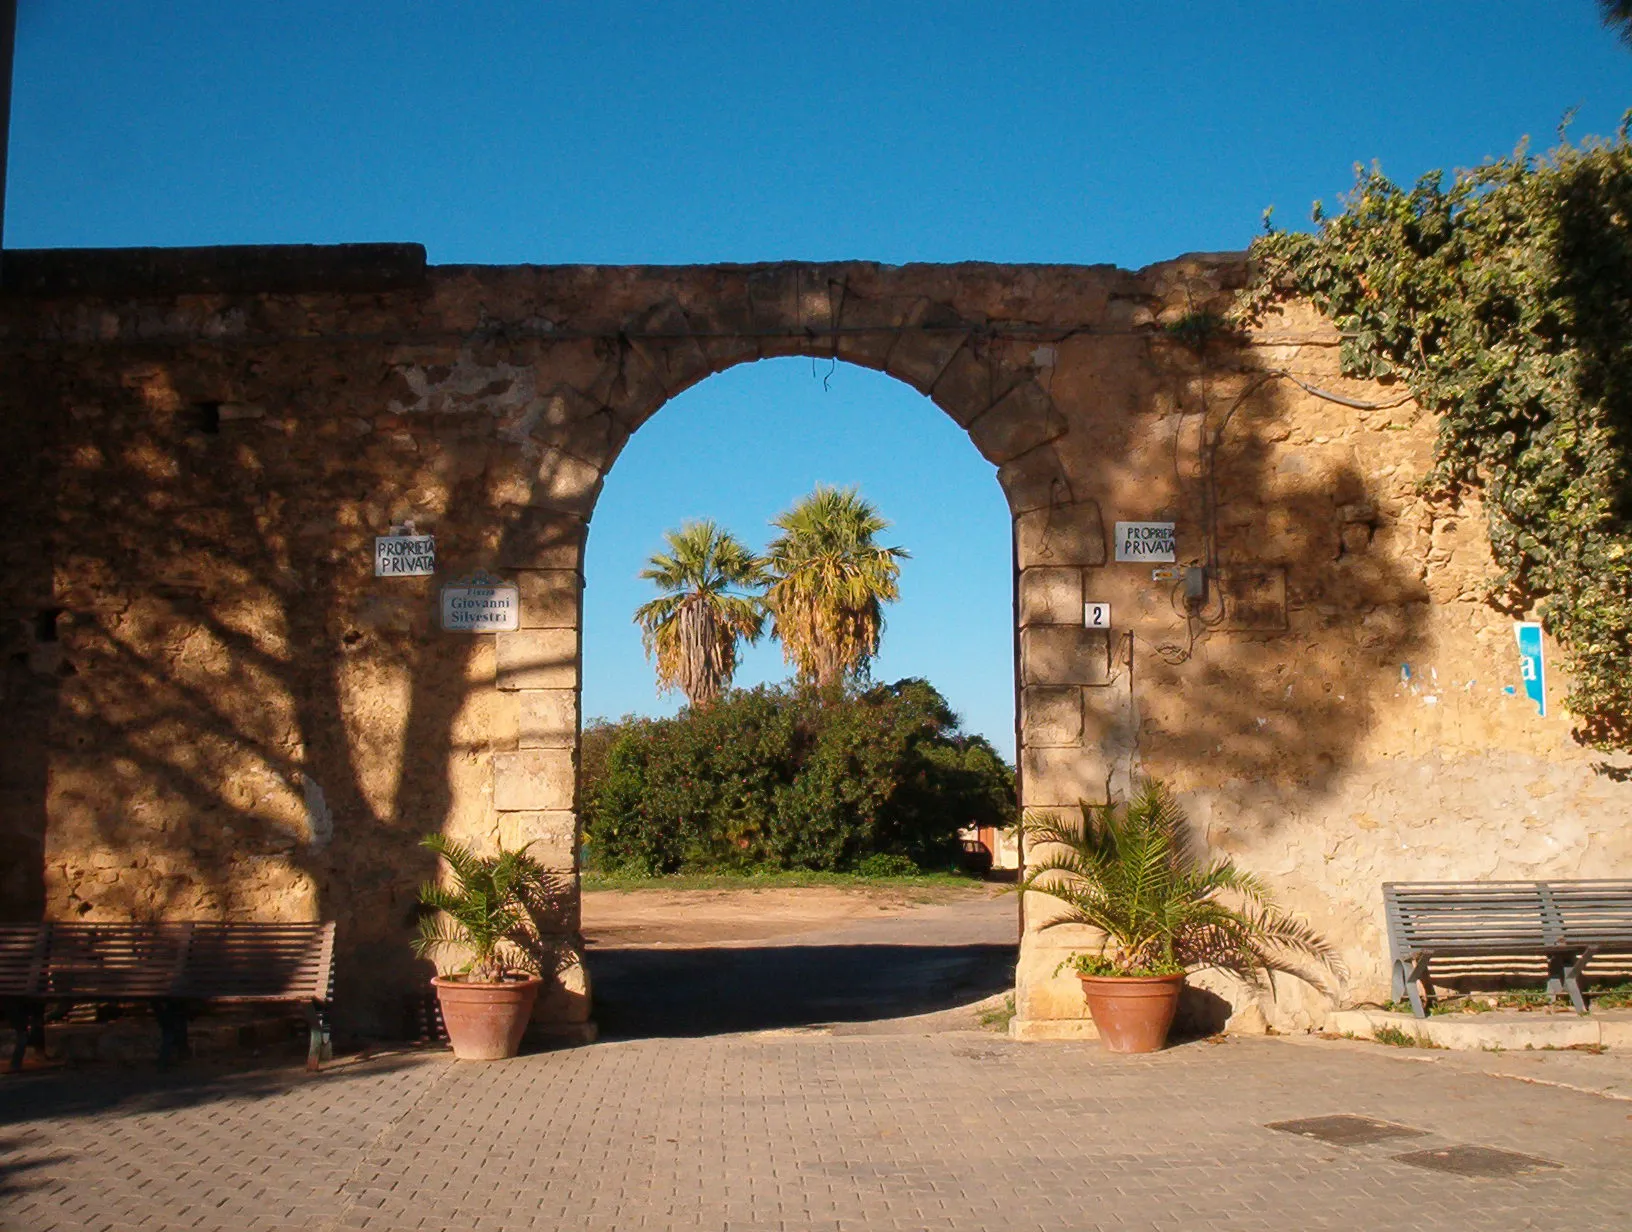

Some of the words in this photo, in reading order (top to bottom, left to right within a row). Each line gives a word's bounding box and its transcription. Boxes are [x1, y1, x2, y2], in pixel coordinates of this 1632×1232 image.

[1124, 540, 1175, 555] PRIVATA
[382, 556, 435, 573] PRIVATA
[451, 597, 510, 609] Giovanni
[451, 611, 507, 623] Silvestri
[1093, 606, 1102, 625] 2
